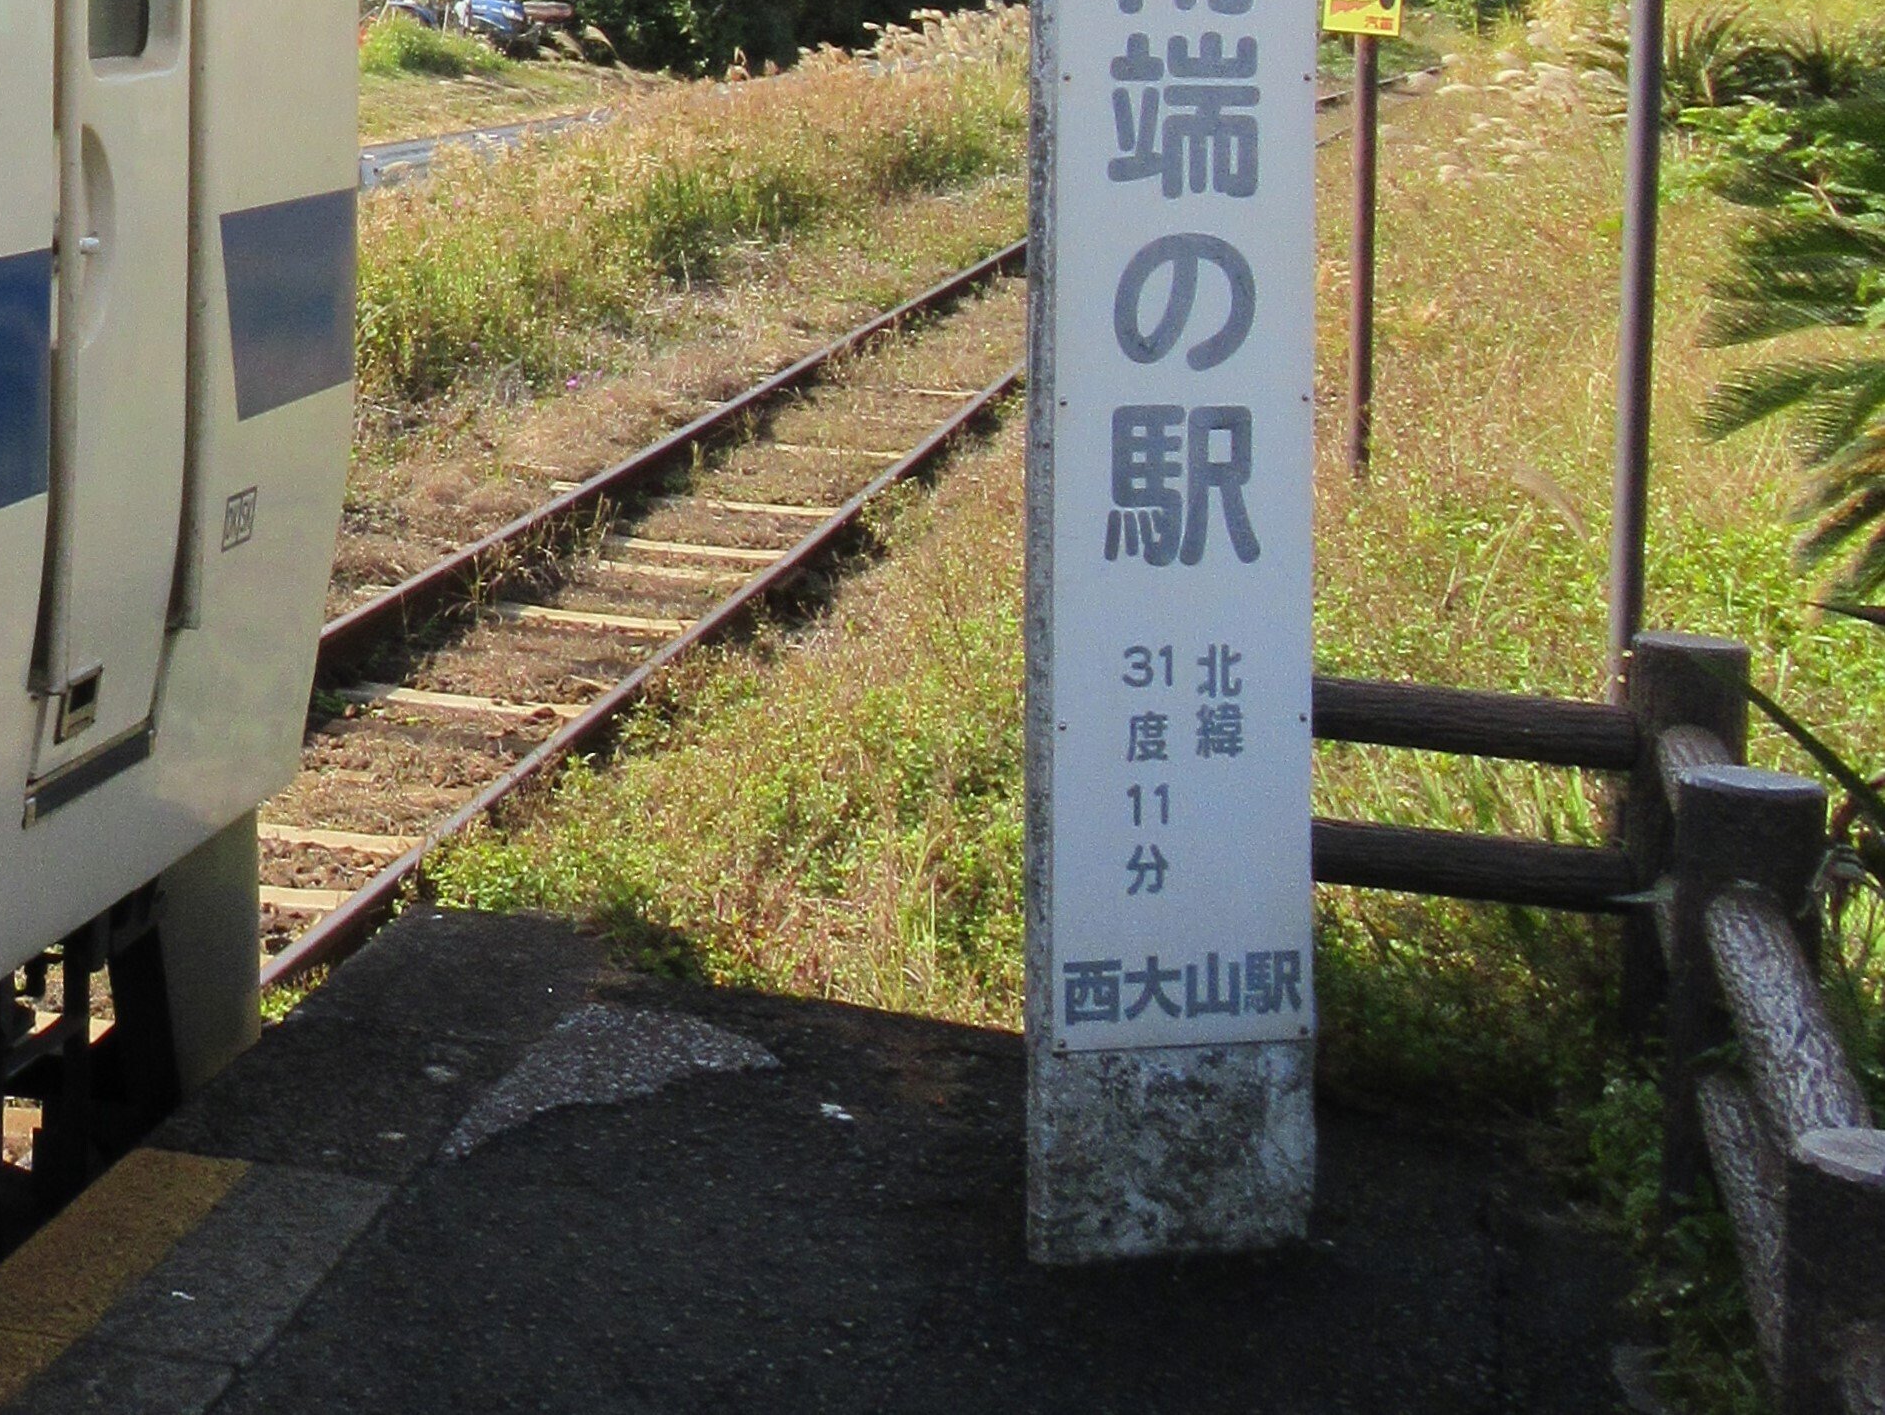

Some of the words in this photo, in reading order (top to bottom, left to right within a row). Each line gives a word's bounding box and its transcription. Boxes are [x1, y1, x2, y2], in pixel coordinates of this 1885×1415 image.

[1195, 644, 1244, 759] 北緯
[1122, 644, 1175, 896] 31度11分
[1063, 949, 1304, 1026] 西大山駅
